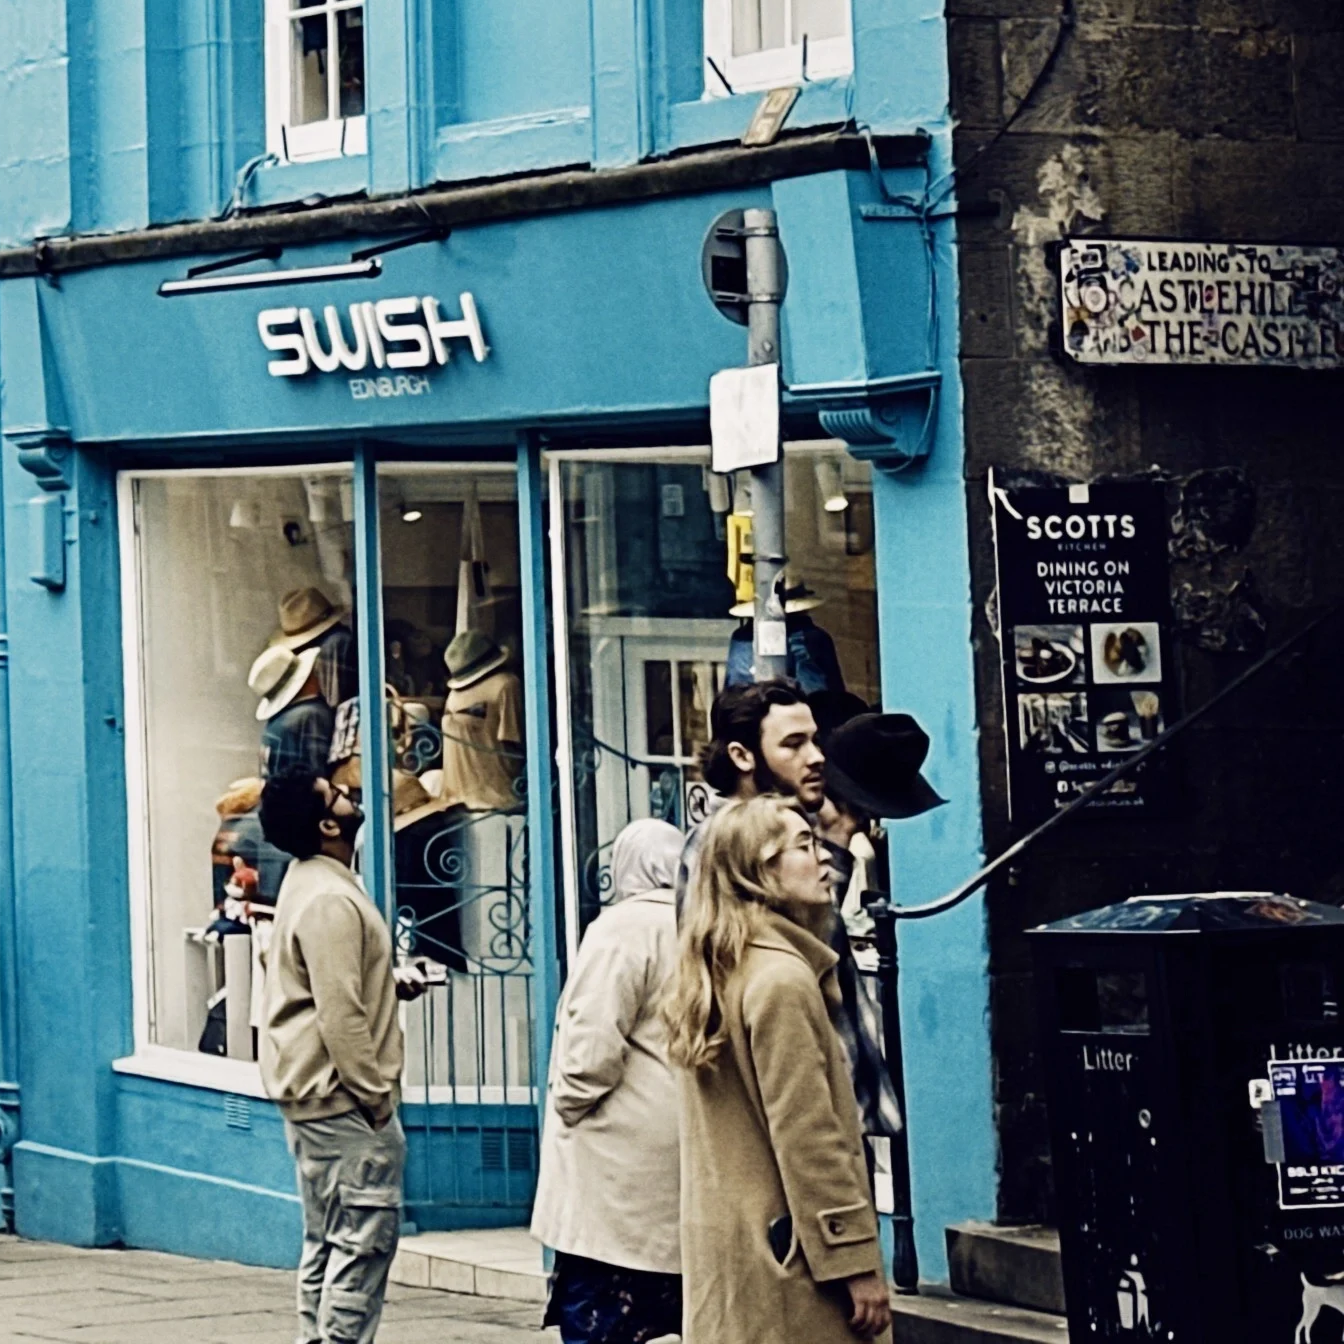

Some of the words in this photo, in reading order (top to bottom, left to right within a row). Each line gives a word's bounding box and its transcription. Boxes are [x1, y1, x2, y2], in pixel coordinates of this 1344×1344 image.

[1147, 250, 1229, 274] LEADING
[1247, 254, 1271, 275] TO
[258, 291, 486, 377] SWISH
[1141, 320, 1205, 355] THE
[348, 375, 432, 400] EDINBURGH
[1026, 514, 1136, 540] SCOTTS
[1036, 560, 1099, 578] DINING
[1103, 560, 1130, 576] ON
[1044, 579, 1124, 596] VICTORIA
[1047, 597, 1124, 615] TERRACE
[1083, 1044, 1133, 1071] Litter
[1283, 1226, 1314, 1240] DOG
